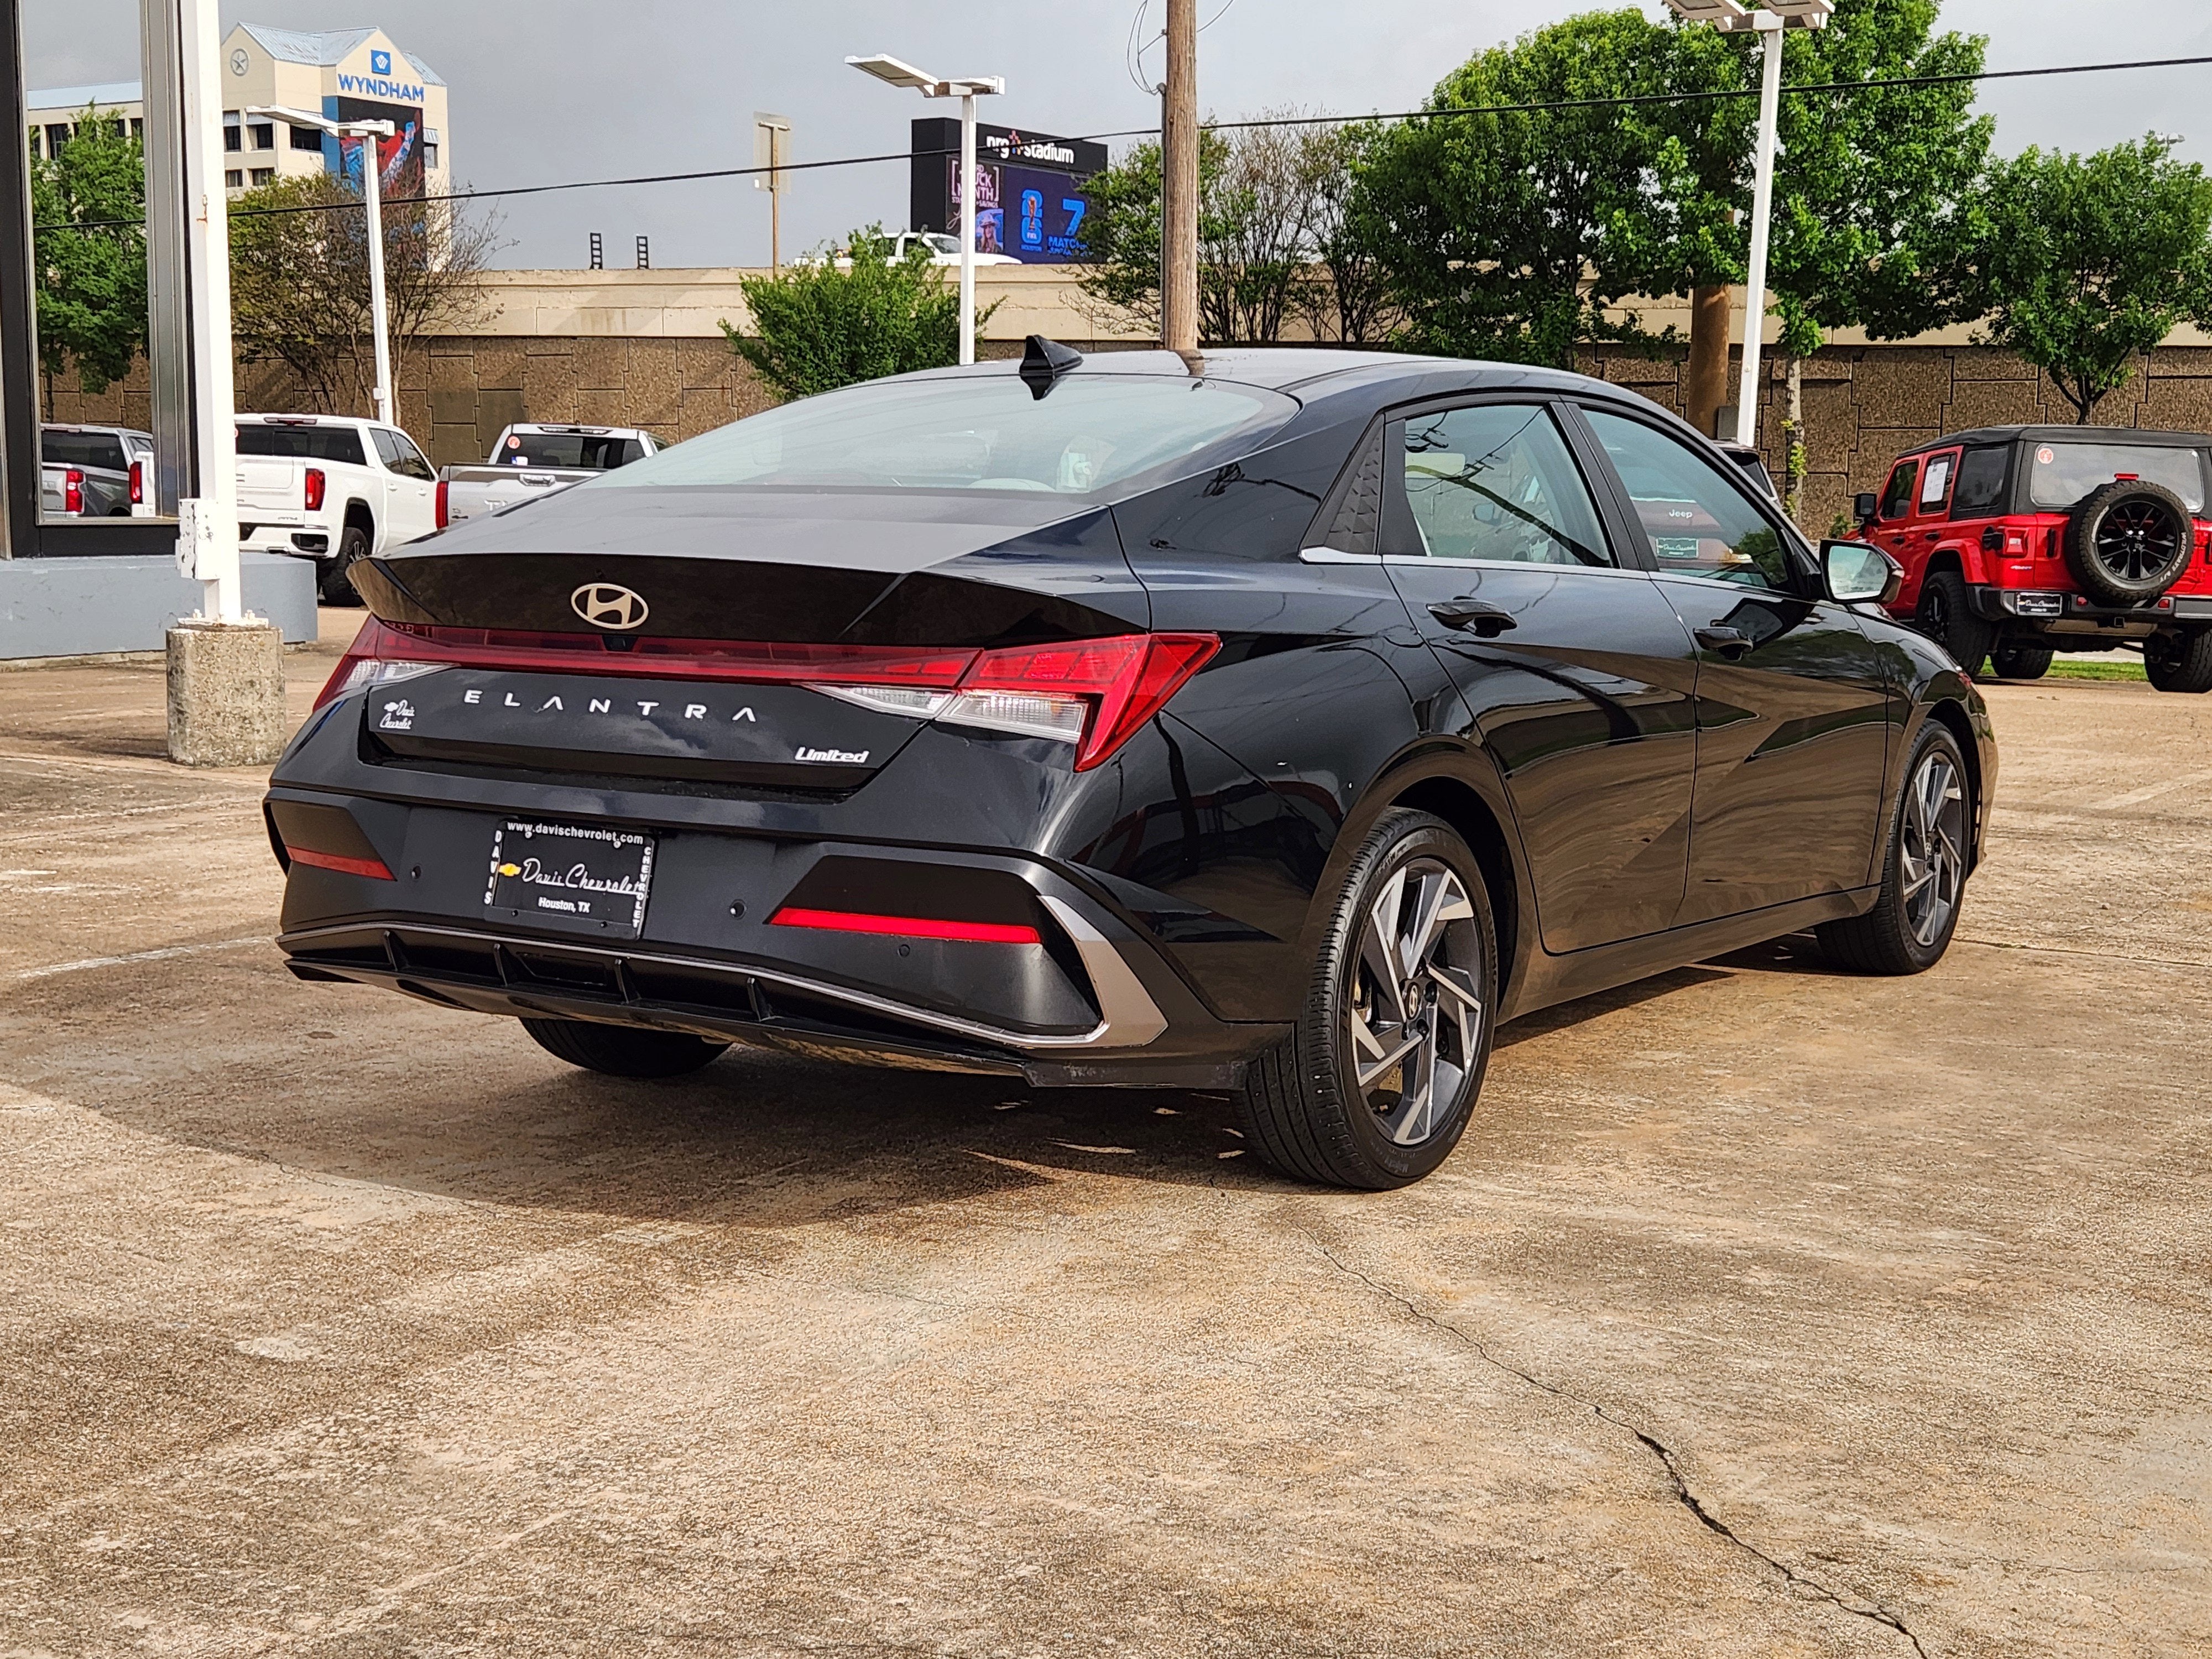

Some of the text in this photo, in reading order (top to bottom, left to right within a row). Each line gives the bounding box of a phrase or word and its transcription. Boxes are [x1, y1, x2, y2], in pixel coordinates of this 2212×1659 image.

[338, 73, 424, 102] WYNDHAM
[1024, 139, 1074, 164] stadium
[1063, 198, 1085, 236] 7
[1669, 509, 1693, 519] Jeep
[464, 689, 757, 723] ELANTRA
[795, 747, 869, 763] Limited
[507, 822, 644, 844] www.davischevrolet.com
[484, 830, 502, 905] DAVIS
[522, 858, 639, 894] Davis Chevrolet
[633, 847, 652, 928] CHEVROLET
[538, 896, 591, 912] Houston, TX
